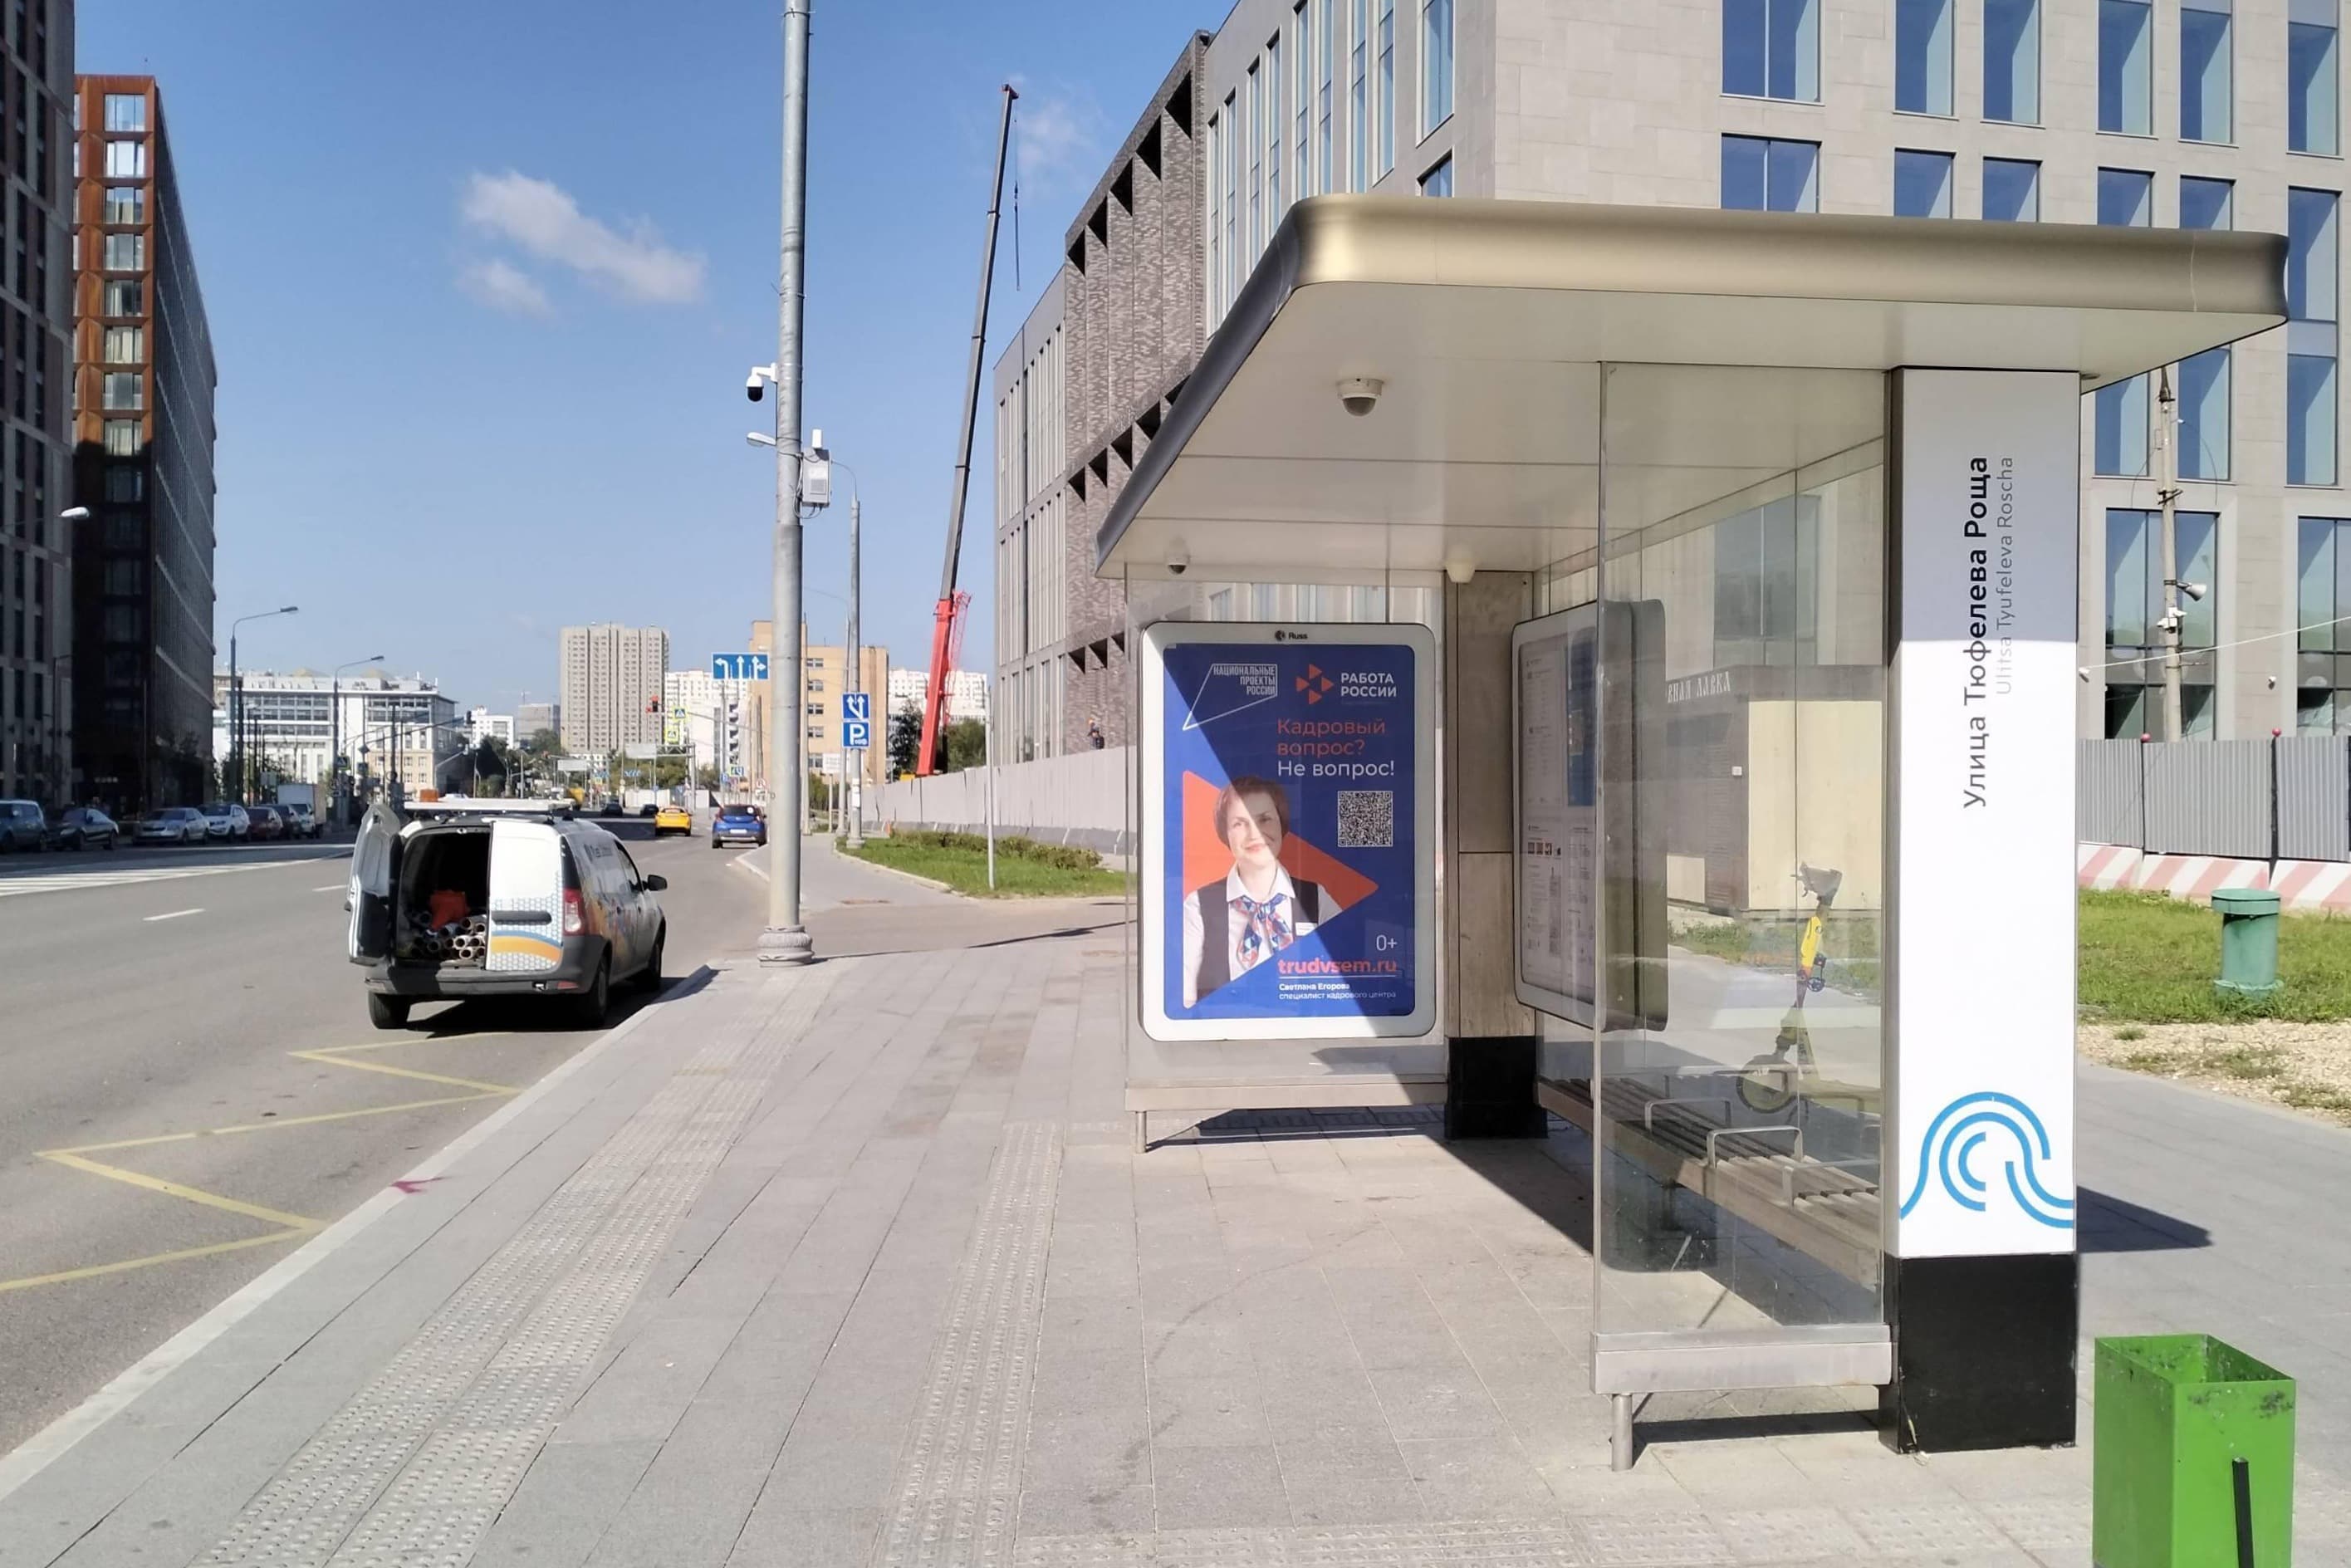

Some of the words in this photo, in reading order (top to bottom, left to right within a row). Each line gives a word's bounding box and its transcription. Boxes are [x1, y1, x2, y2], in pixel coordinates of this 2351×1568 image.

[1964, 458, 1991, 537] Роща
[1996, 458, 2013, 528] Roscha
[1996, 536, 2015, 630] Tyufeleva
[1288, 631, 1308, 639] Russ
[1962, 550, 1991, 706] Тюфелева
[1212, 665, 1276, 676] НАЦИОНАЛЬНЫЕ
[1996, 636, 2012, 694] Ulitsa
[1240, 676, 1276, 685] ПРОЕКТЫ
[1341, 673, 1394, 684] РАБОТА
[1247, 686, 1276, 695] РОССИИ
[1341, 686, 1397, 697] РОССИИ
[1277, 718, 1386, 737] Кадровый
[1278, 738, 1365, 758] вопрос?
[1278, 760, 1305, 777] Не
[1312, 760, 1394, 780] вопрос!
[1963, 717, 1990, 808] Улица
[1376, 934, 1398, 951] 0+
[1278, 957, 1397, 973] trudvsem.ru
[1318, 982, 1350, 992] Егорова
[1279, 992, 1325, 1001] специалист
[1326, 992, 1367, 1001] кадрового
[1369, 991, 1396, 999] центра
